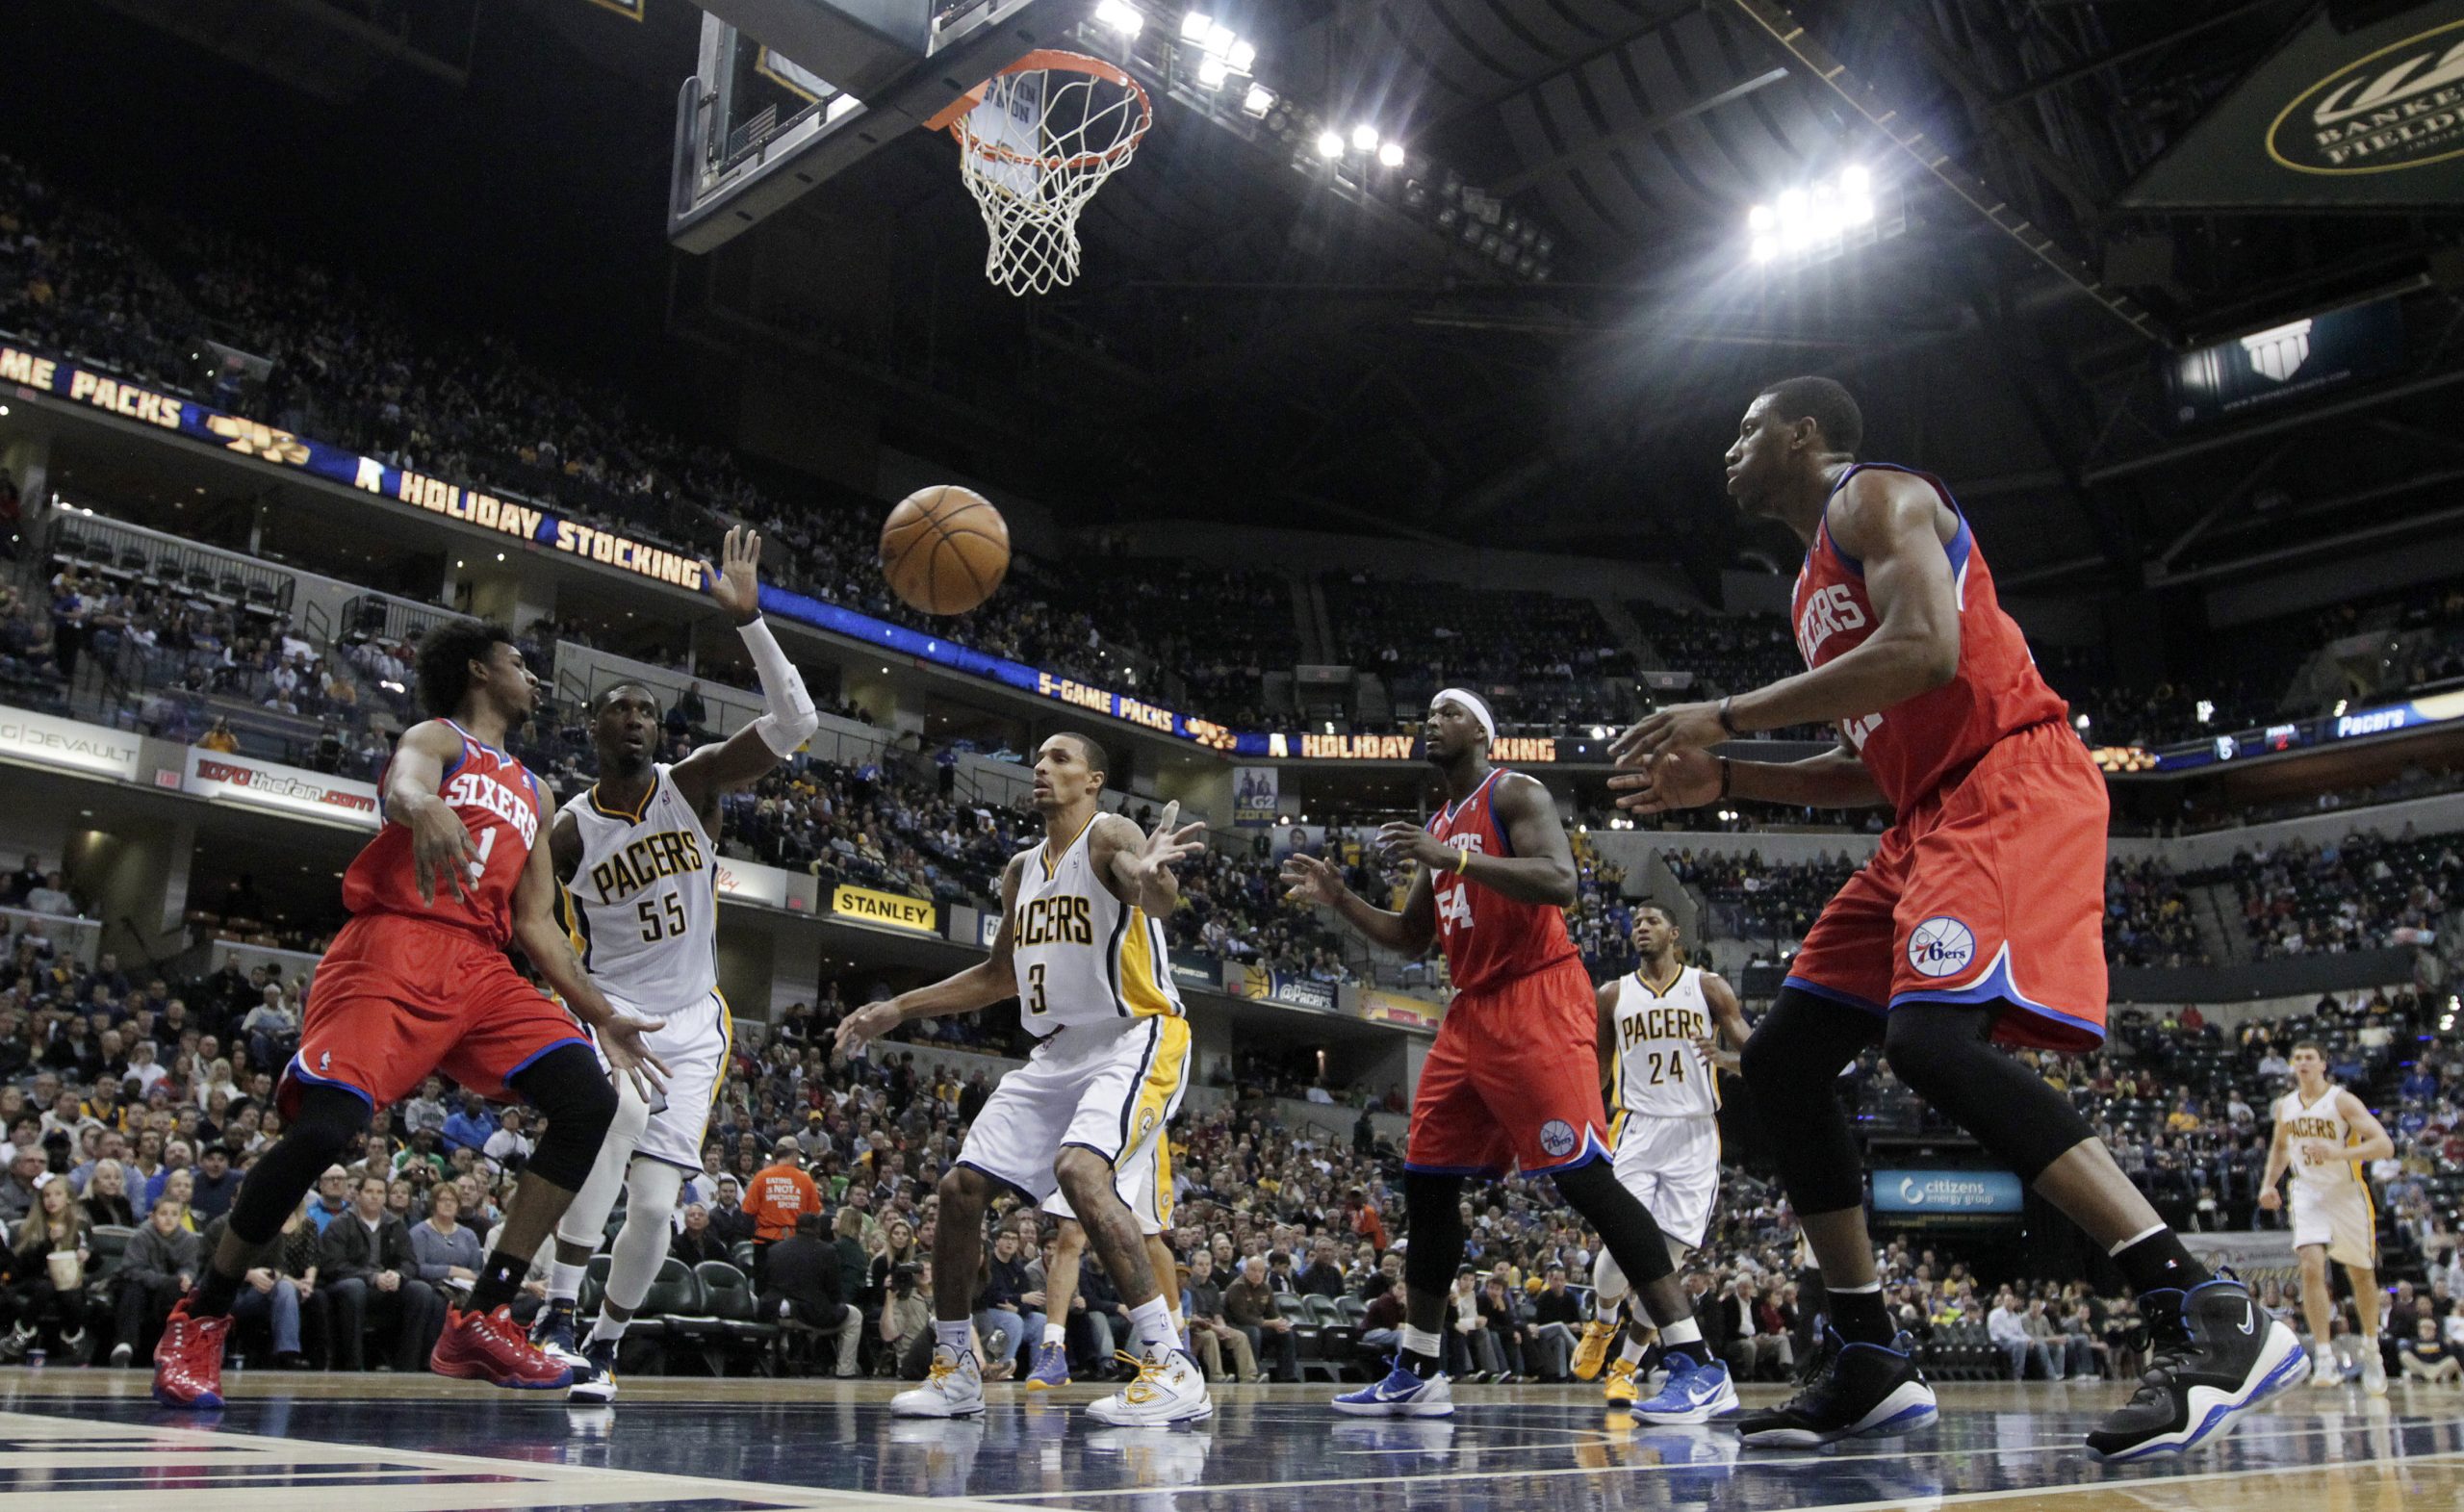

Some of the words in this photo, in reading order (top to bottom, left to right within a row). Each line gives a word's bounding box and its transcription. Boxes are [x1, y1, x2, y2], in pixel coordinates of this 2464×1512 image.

[2316, 84, 2464, 145] BANKE
[70, 370, 183, 428] PACKS
[354, 456, 383, 494] A
[398, 471, 542, 541] HOLIDAY
[555, 520, 702, 591] STOCKING
[1039, 672, 1112, 713] 5-GAME
[1119, 697, 1173, 732] PACKS
[2338, 708, 2406, 738] Pacers
[1268, 732, 1289, 757] A
[1301, 734, 1415, 760] HOLIDAY
[1488, 737, 1556, 762] KING
[196, 757, 375, 812] 1070thefan.com
[1251, 795, 1276, 809] G2
[445, 773, 538, 851] SIXERS
[593, 830, 704, 906] PACERS
[637, 891, 687, 944] 55
[841, 893, 930, 925] STANLEY
[1014, 894, 1094, 949] ACERS
[1434, 882, 1476, 935] 54
[1914, 940, 1966, 963] 76ers
[1027, 961, 1049, 1016] 3
[1280, 983, 1333, 1009] @Pacers
[1622, 1008, 1704, 1051] PACERS
[1648, 1049, 1684, 1087] 24
[1543, 1134, 1572, 1150] 76ers
[2286, 1116, 2337, 1140] PACERS
[774, 1185, 794, 1194] NOT
[1926, 1179, 1984, 1194] citizens
[1927, 1194, 1963, 1206] energy
[1965, 1194, 1994, 1207] group
